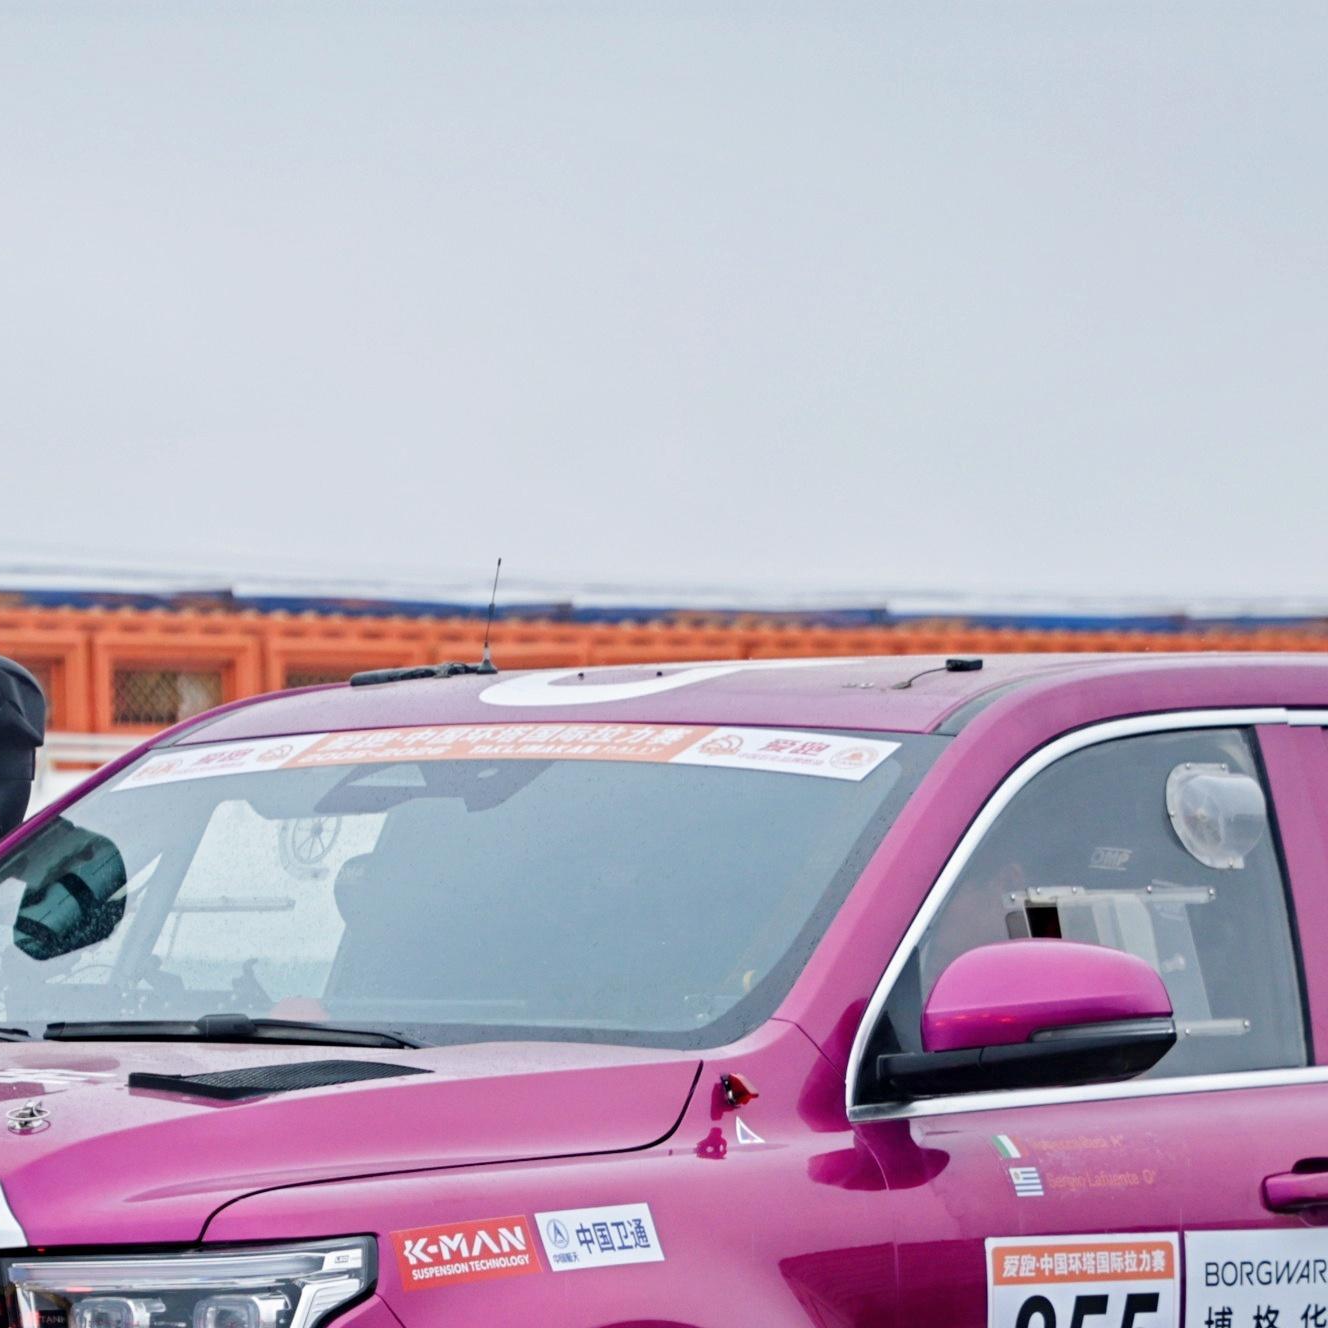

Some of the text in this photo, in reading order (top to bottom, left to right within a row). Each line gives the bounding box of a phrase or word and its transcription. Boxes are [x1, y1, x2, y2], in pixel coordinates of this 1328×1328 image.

[404, 1225, 527, 1266] K-MAN
[576, 1218, 651, 1254] 中国卫通
[412, 1254, 530, 1280] SUSPENSION TECHNOLOGY
